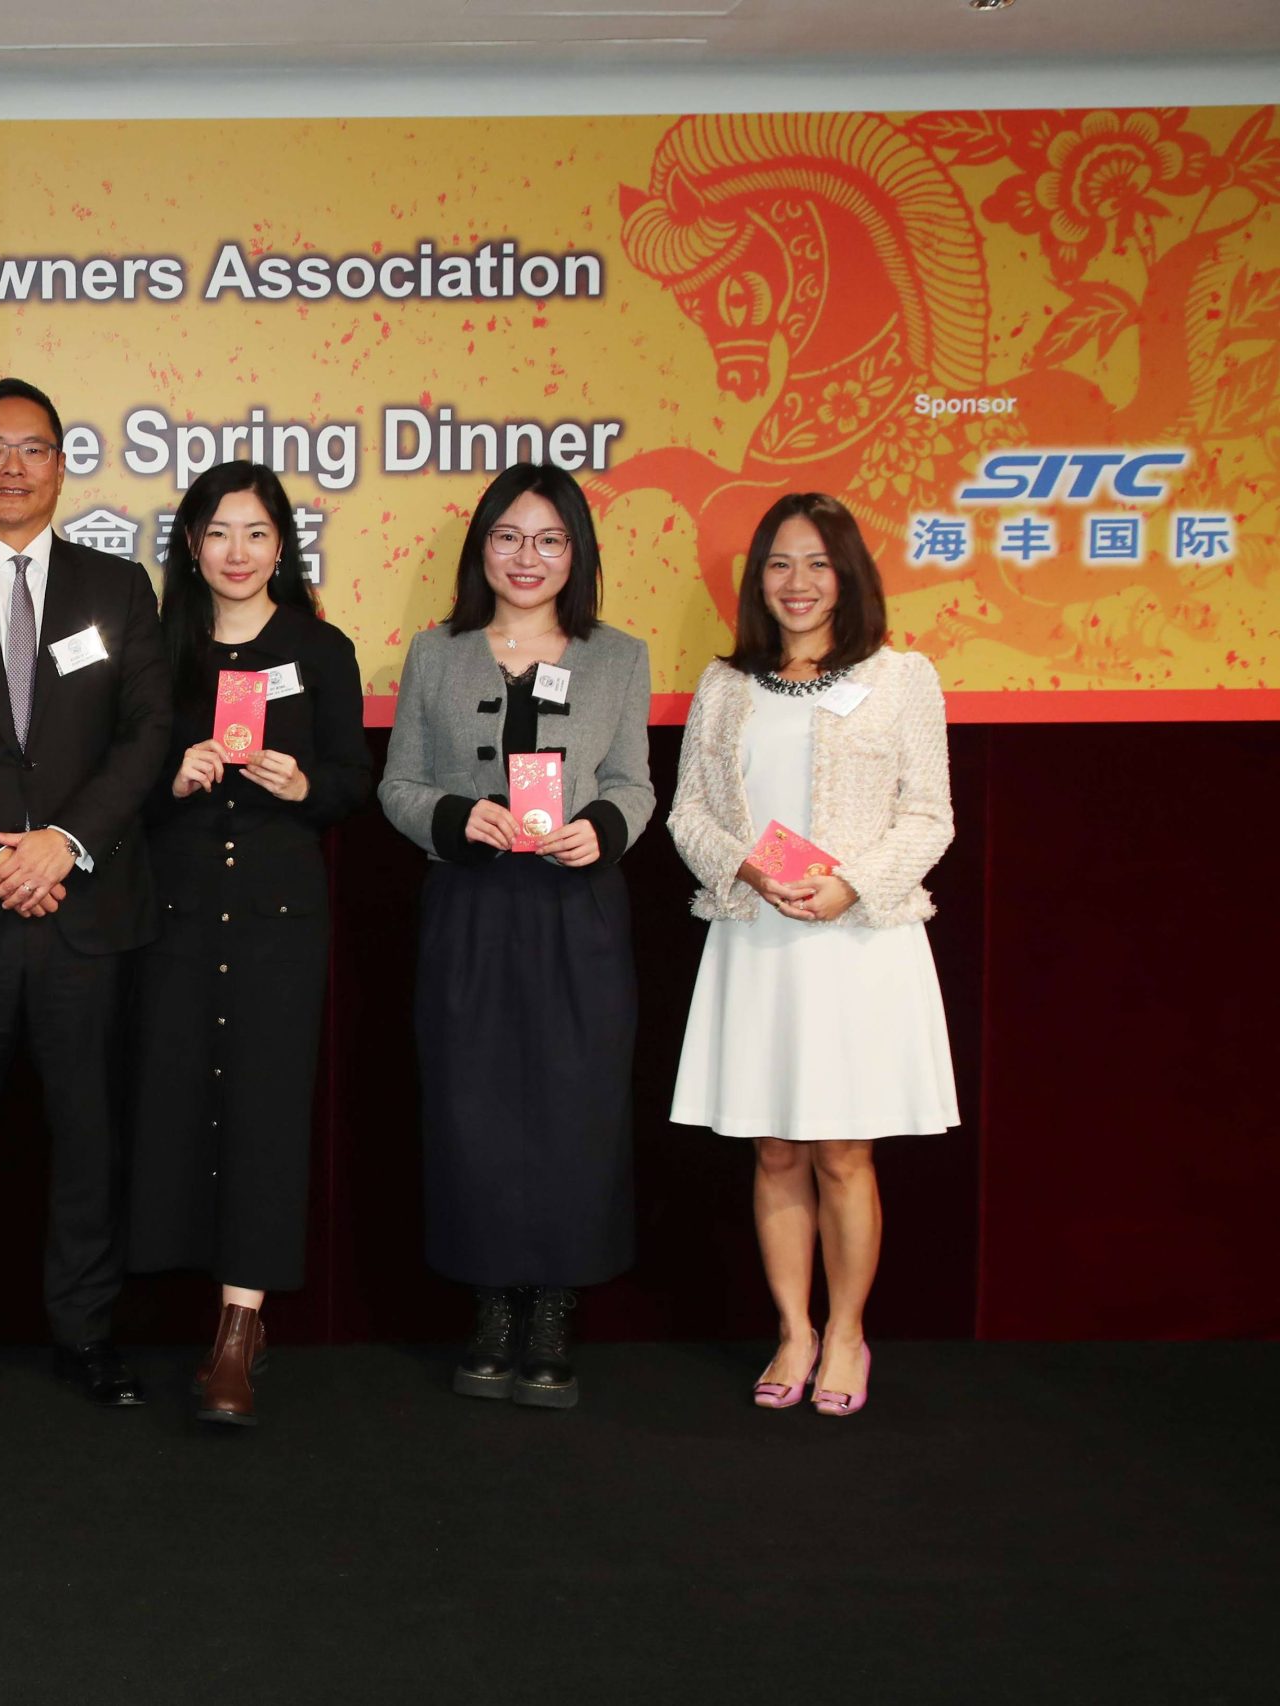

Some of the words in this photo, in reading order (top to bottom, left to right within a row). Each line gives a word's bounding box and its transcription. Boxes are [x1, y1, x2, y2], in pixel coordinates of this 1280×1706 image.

[205, 243, 600, 299] Association
[915, 394, 1017, 418] Sponsor
[124, 409, 356, 489] Spring
[385, 408, 620, 471] Dinner
[960, 453, 1186, 499] SITC
[912, 516, 1230, 562] 海丰国际
